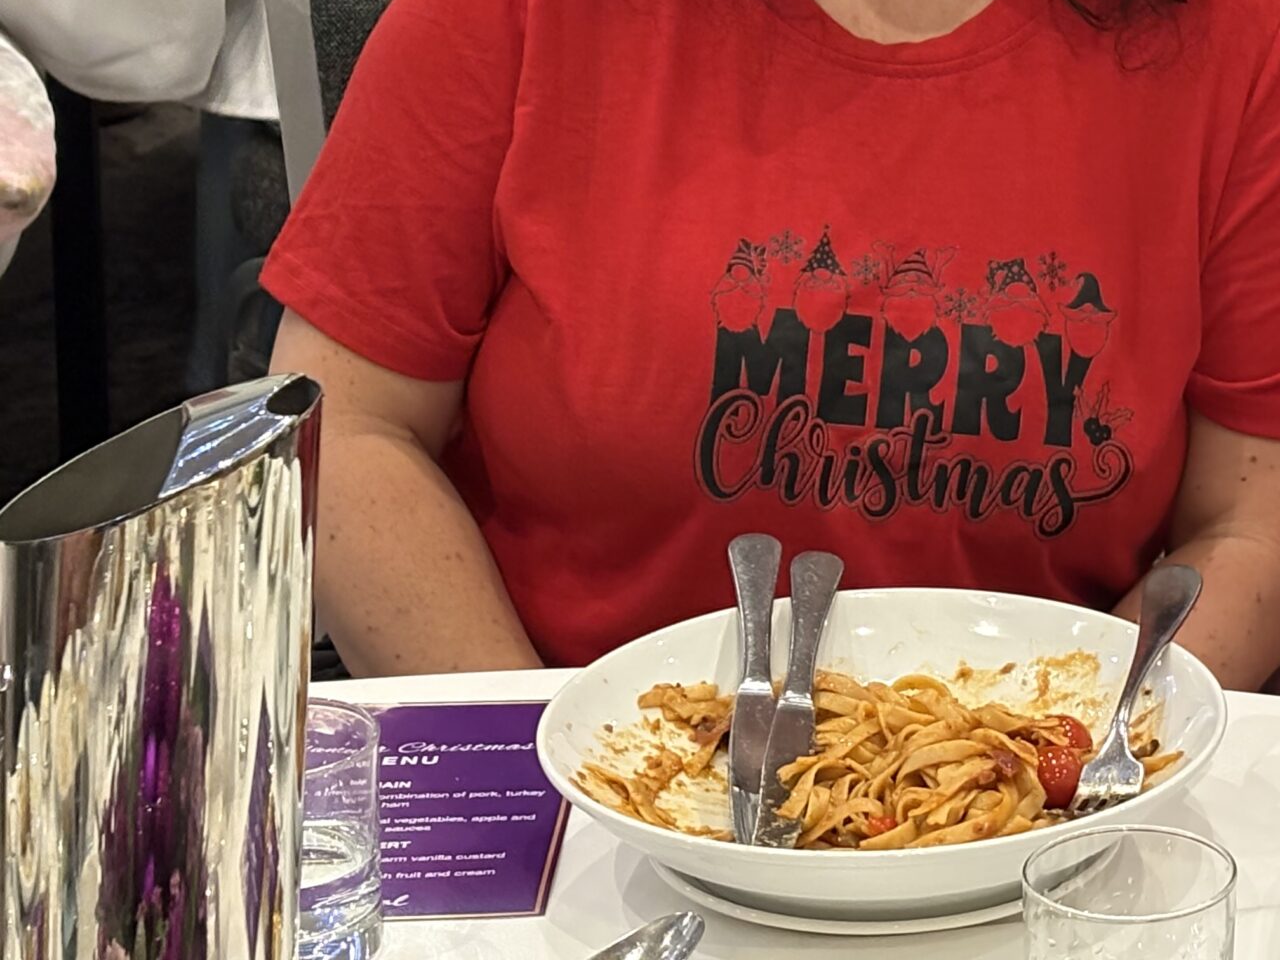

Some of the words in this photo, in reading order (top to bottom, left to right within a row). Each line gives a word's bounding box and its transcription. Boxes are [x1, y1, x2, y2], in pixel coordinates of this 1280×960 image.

[711, 307, 1095, 448] MERRY
[694, 387, 1134, 539] Christmas
[398, 741, 536, 754] Christmas
[380, 755, 440, 766] ENU
[378, 780, 412, 789] AIN
[378, 791, 450, 801] ombination
[453, 791, 466, 799] of
[506, 789, 547, 798] turkey
[471, 814, 508, 823] apple
[511, 813, 536, 822] and
[380, 855, 407, 864] arm
[455, 851, 507, 861] custard
[425, 870, 451, 879] and
[454, 869, 497, 878] cream
